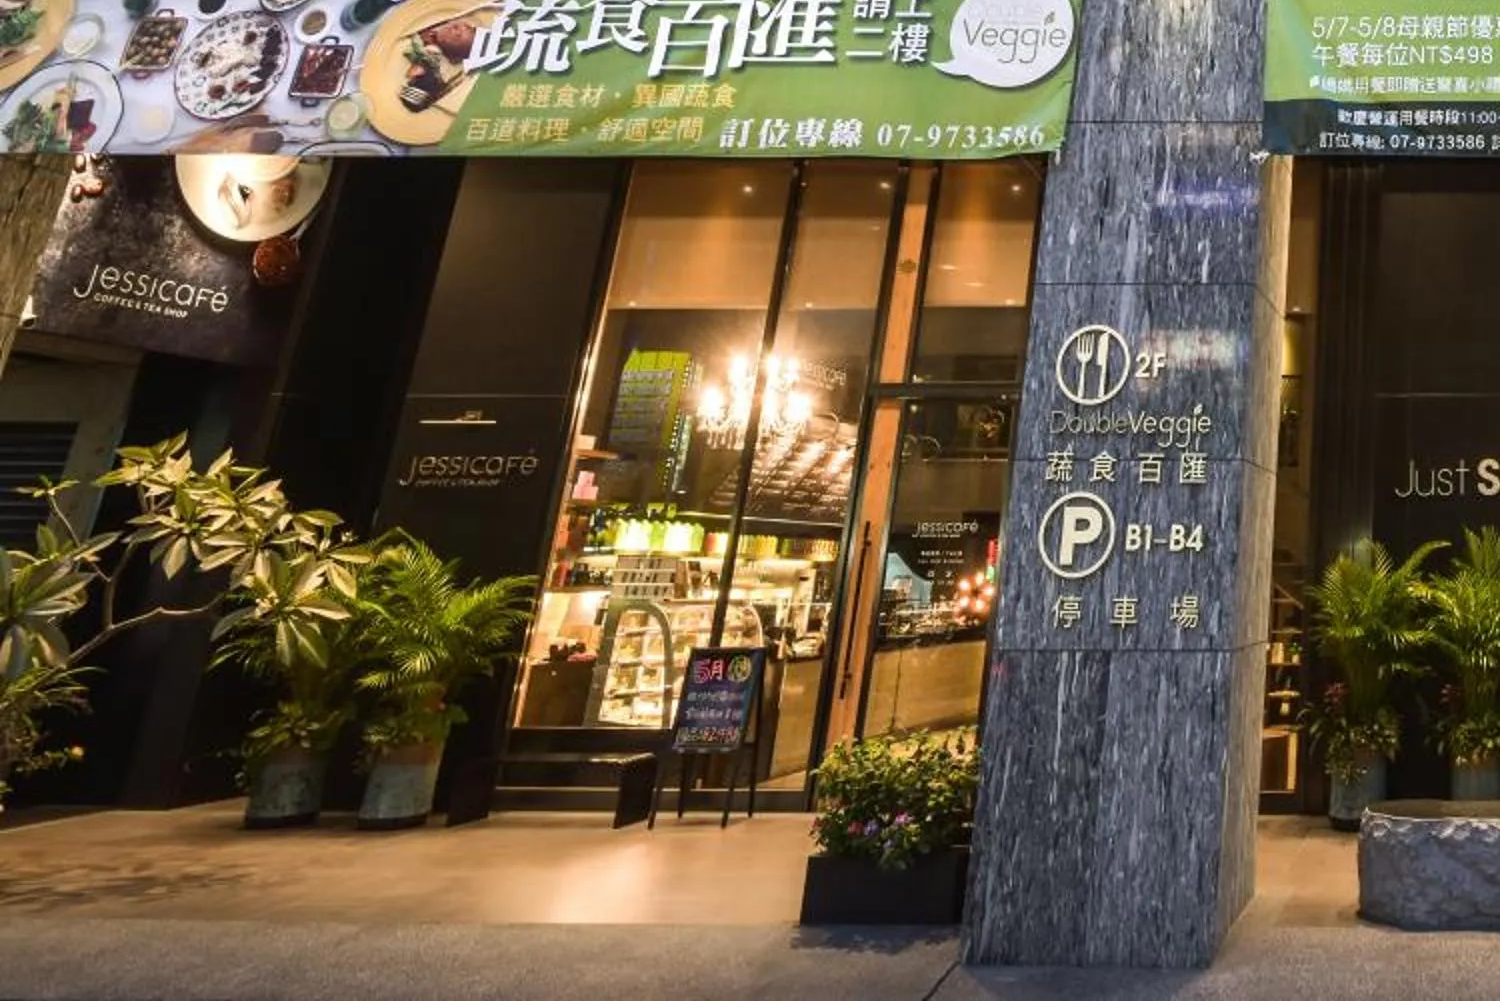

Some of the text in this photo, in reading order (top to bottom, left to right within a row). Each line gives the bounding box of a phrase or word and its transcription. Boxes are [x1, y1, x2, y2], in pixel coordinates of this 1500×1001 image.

[845, 22, 931, 62] 二樓
[963, 11, 1068, 64] Veggie
[719, 118, 1046, 148] 訂位專線 07-9733586
[1135, 352, 1168, 379] 2F
[1045, 450, 1209, 485] 蔬食百匯
[1395, 458, 1470, 498] Just
[1059, 506, 1203, 567] P B1-B4
[1052, 596, 1200, 629] 停車場
